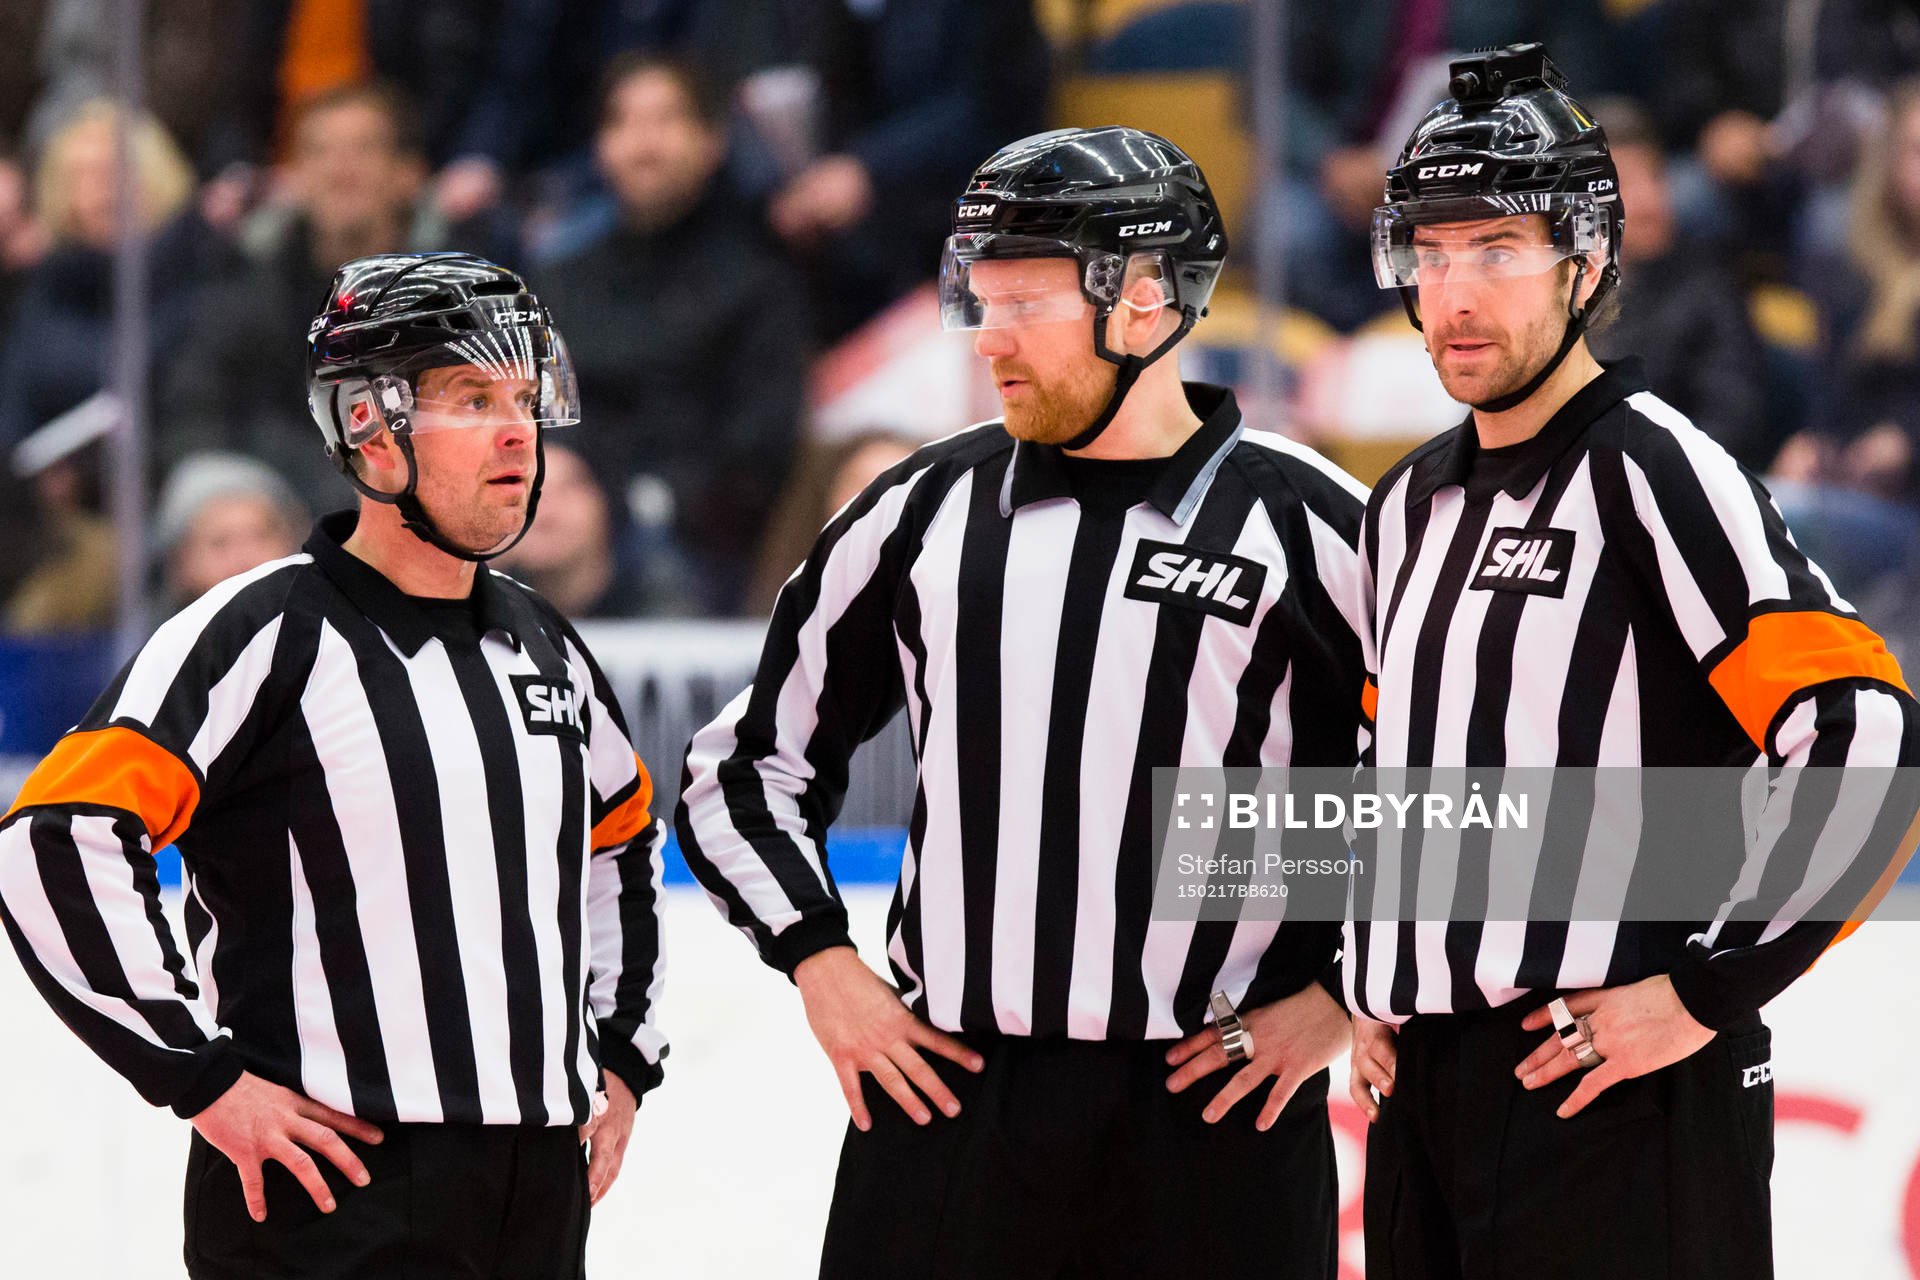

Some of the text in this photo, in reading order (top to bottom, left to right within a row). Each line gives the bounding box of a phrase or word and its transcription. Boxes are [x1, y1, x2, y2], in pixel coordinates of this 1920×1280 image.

[1418, 163, 1483, 179] CCM
[958, 204, 996, 218] CCM
[1119, 220, 1172, 237] CCM
[494, 311, 541, 324] CCM
[1481, 538, 1560, 582] SHL
[1136, 552, 1250, 610] SHL
[1742, 1062, 1772, 1088] CC
